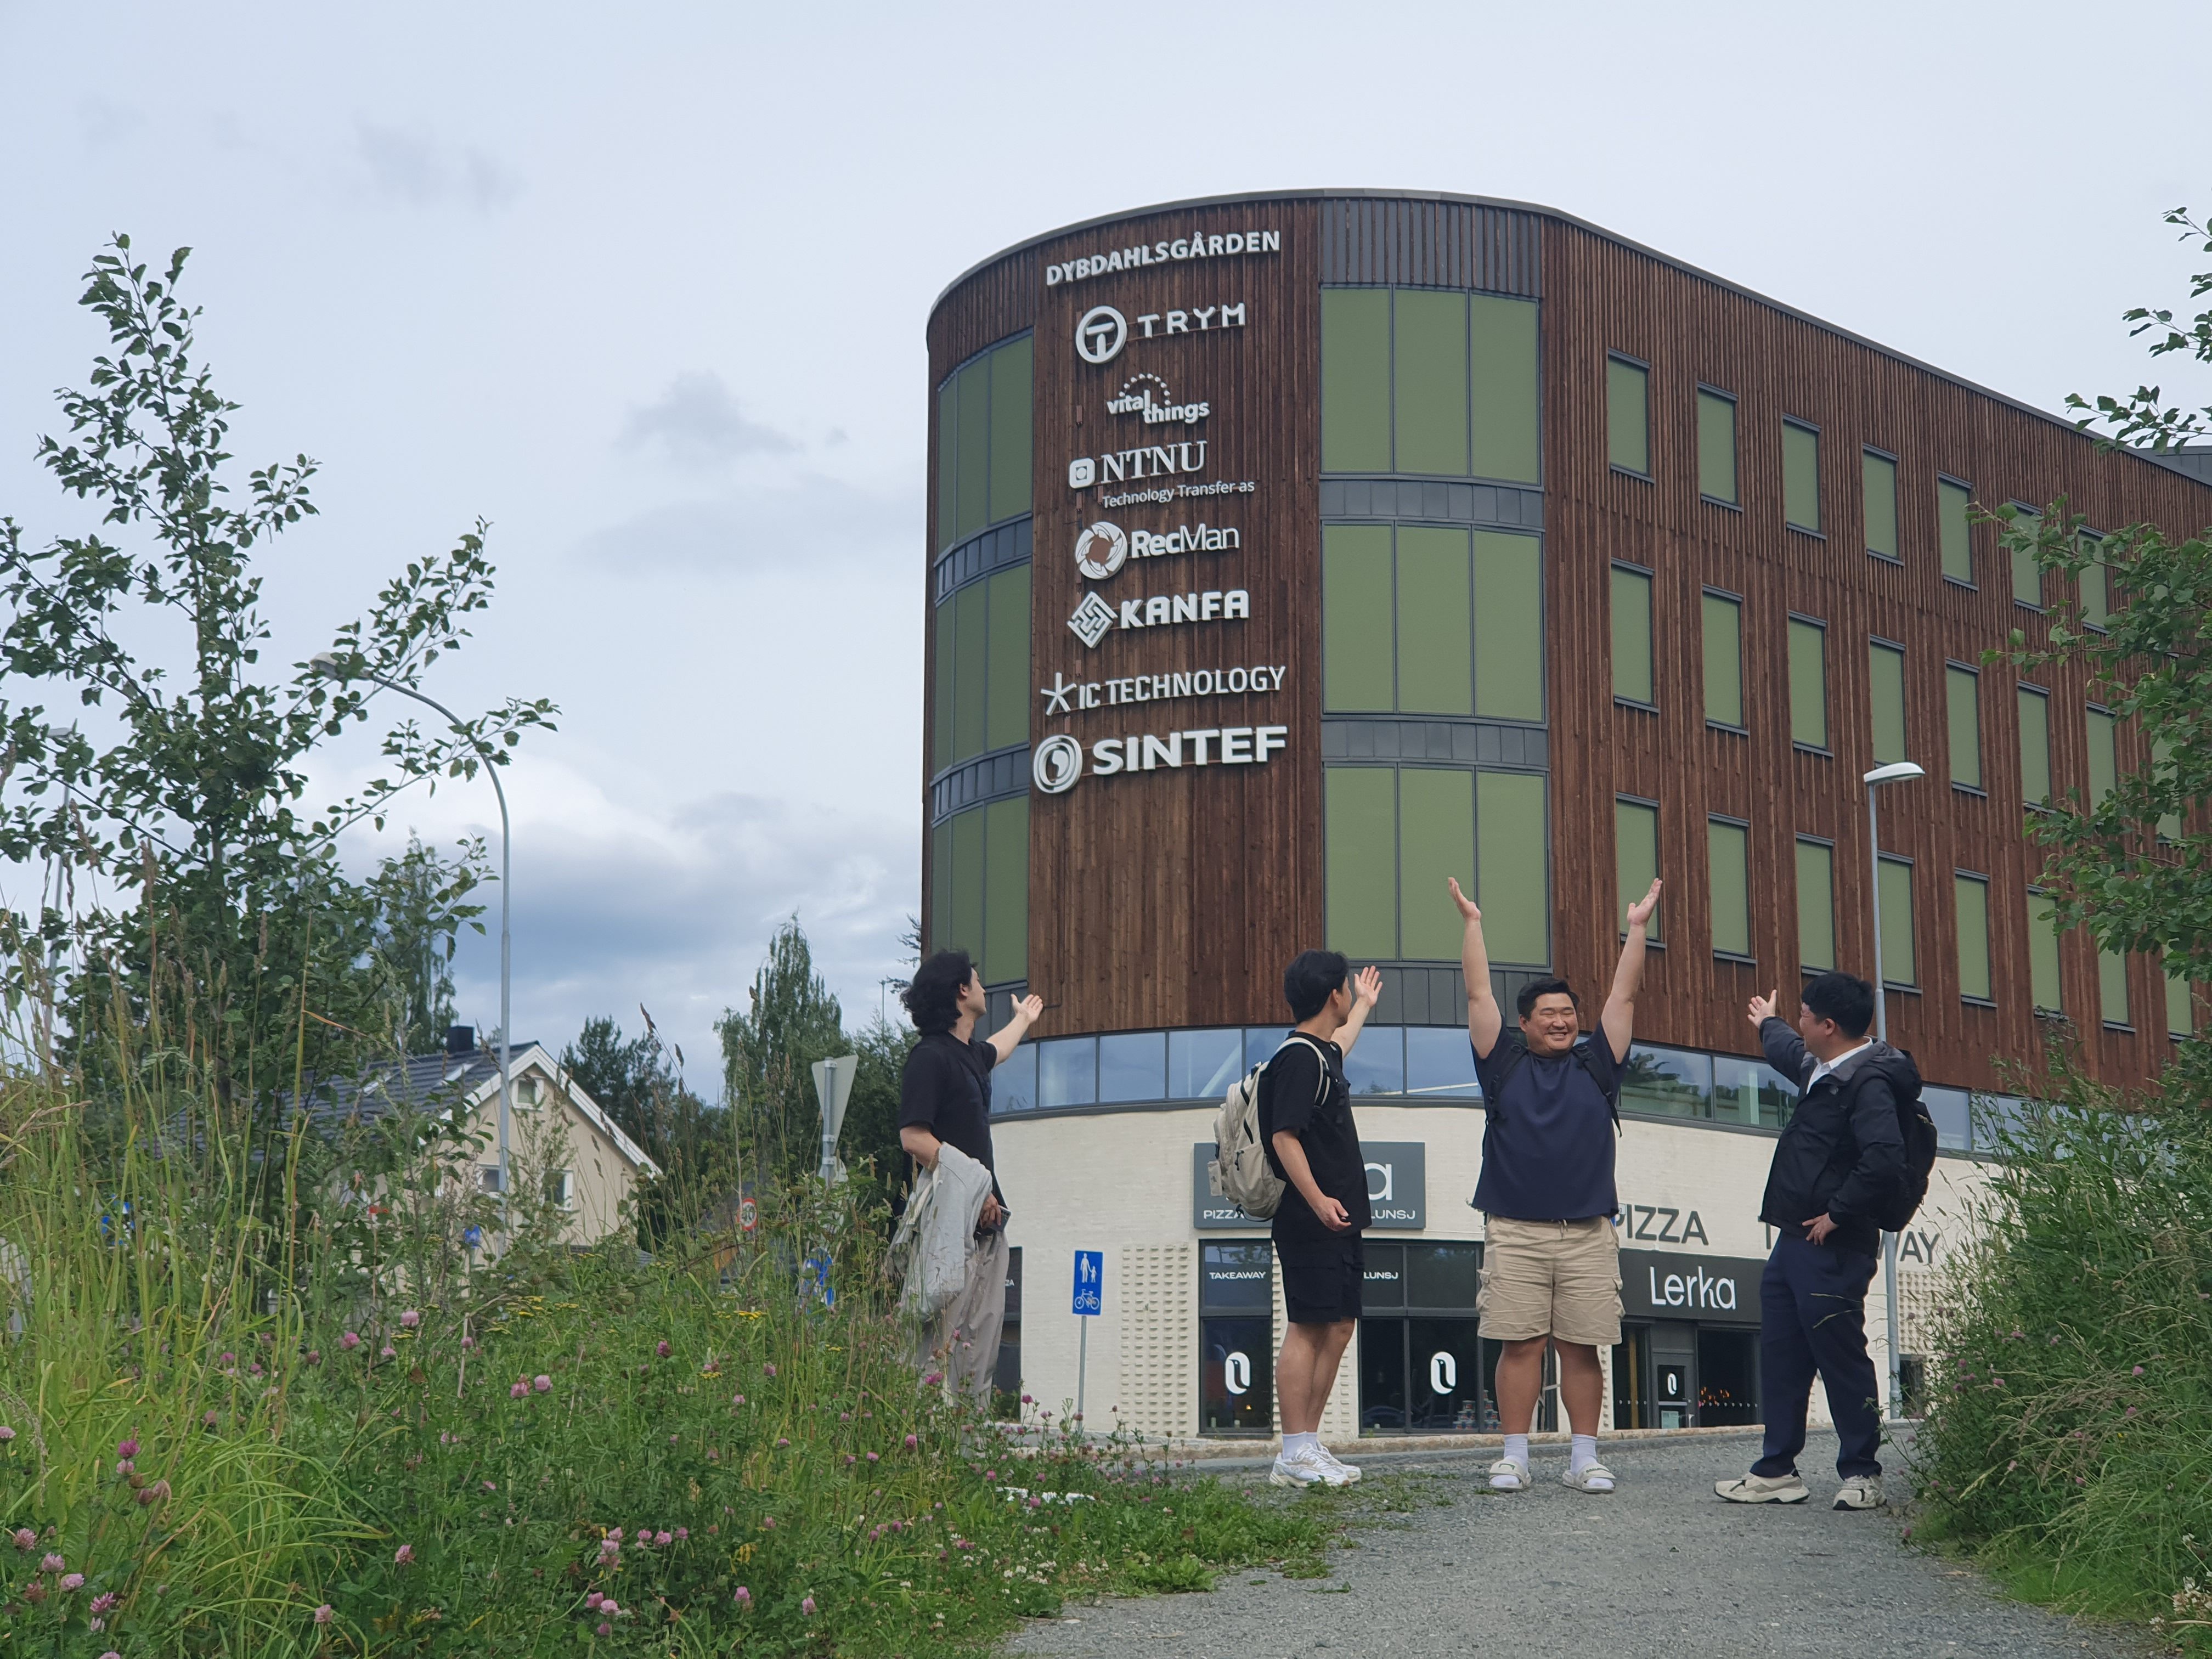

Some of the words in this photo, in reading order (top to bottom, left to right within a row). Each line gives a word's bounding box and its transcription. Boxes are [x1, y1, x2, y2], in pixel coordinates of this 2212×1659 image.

[1046, 231, 1280, 286] DYBDAHLSGÅRDEN
[1137, 303, 1245, 338] TRYM
[1107, 390, 1151, 415] vital
[1143, 402, 1210, 424] things
[1101, 441, 1207, 483] NTNU
[1102, 488, 1175, 508] Technology
[1177, 480, 1235, 497] Transfer
[1238, 482, 1255, 492] as
[1131, 523, 1239, 558] RecMan
[1121, 590, 1249, 629] KANFA
[1105, 665, 1286, 705] TECHNOLOGY
[1093, 725, 1288, 775] SINTEF
[1209, 1271, 1266, 1280] TAKEAWAY
[1650, 1266, 1736, 1310] Lerka
